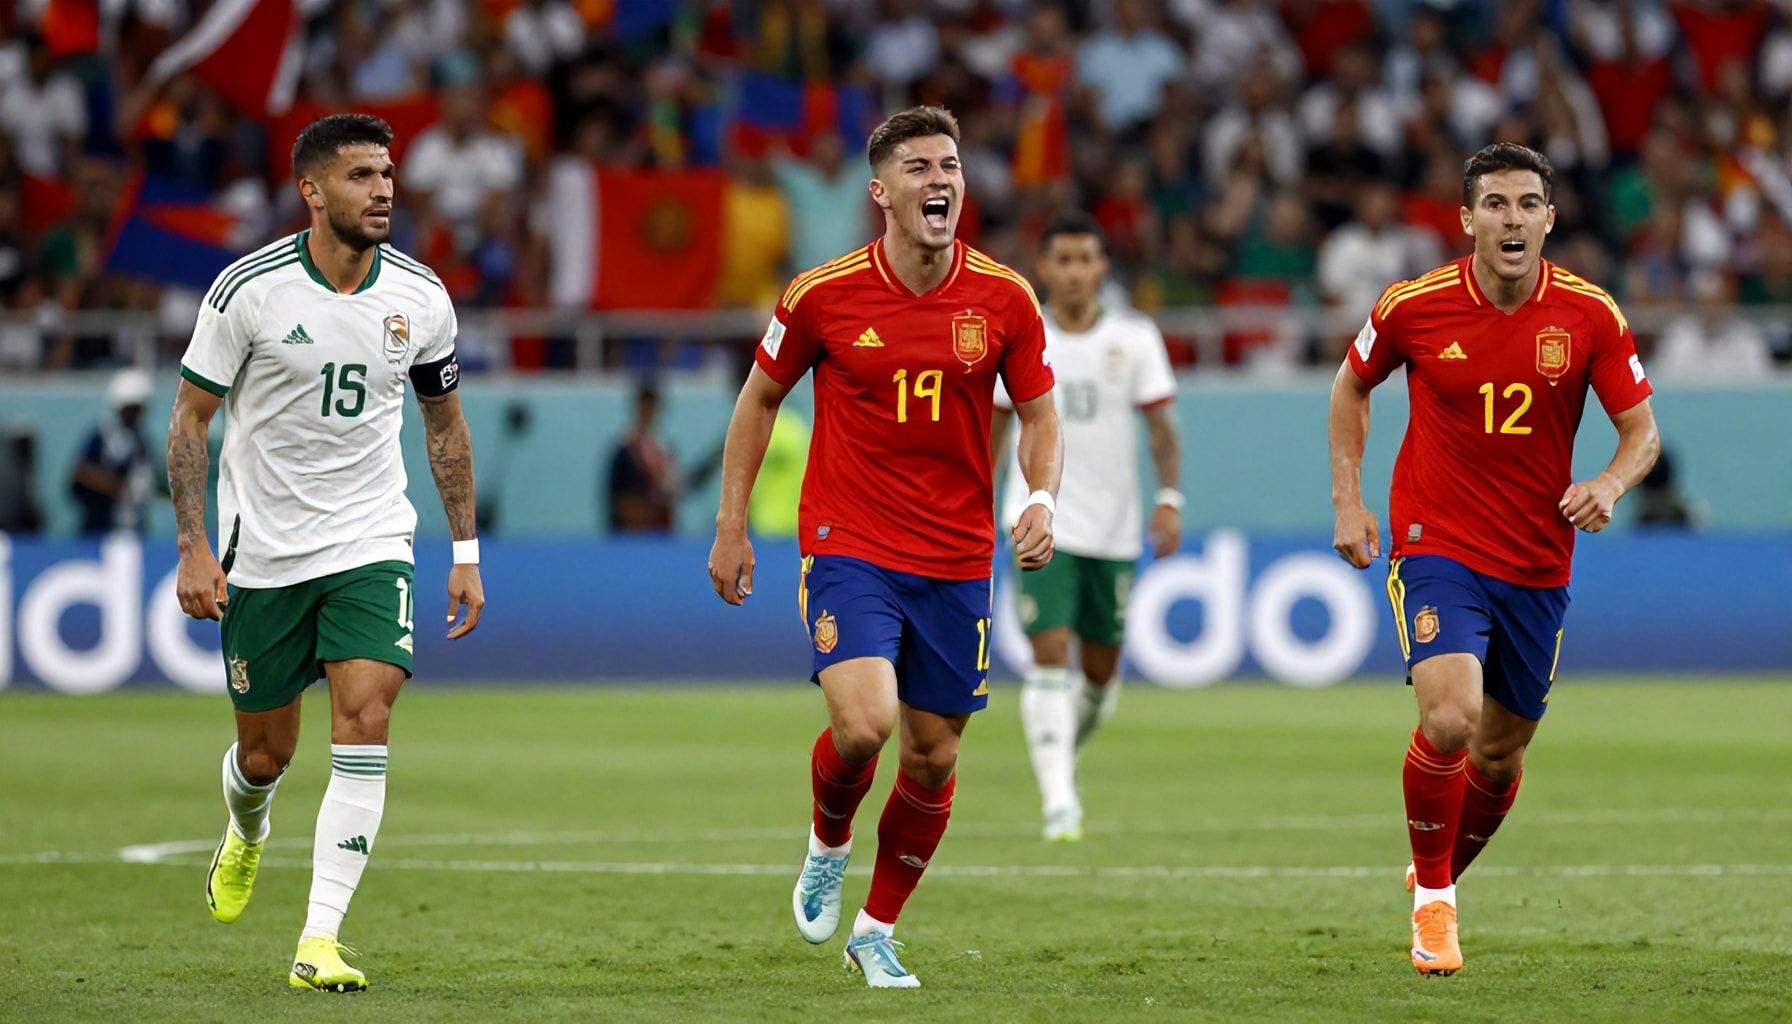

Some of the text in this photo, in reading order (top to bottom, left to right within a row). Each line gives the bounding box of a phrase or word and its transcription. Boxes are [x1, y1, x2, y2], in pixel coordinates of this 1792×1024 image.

[320, 362, 367, 417] 15
[893, 369, 943, 423] 19
[1479, 382, 1533, 435] 12
